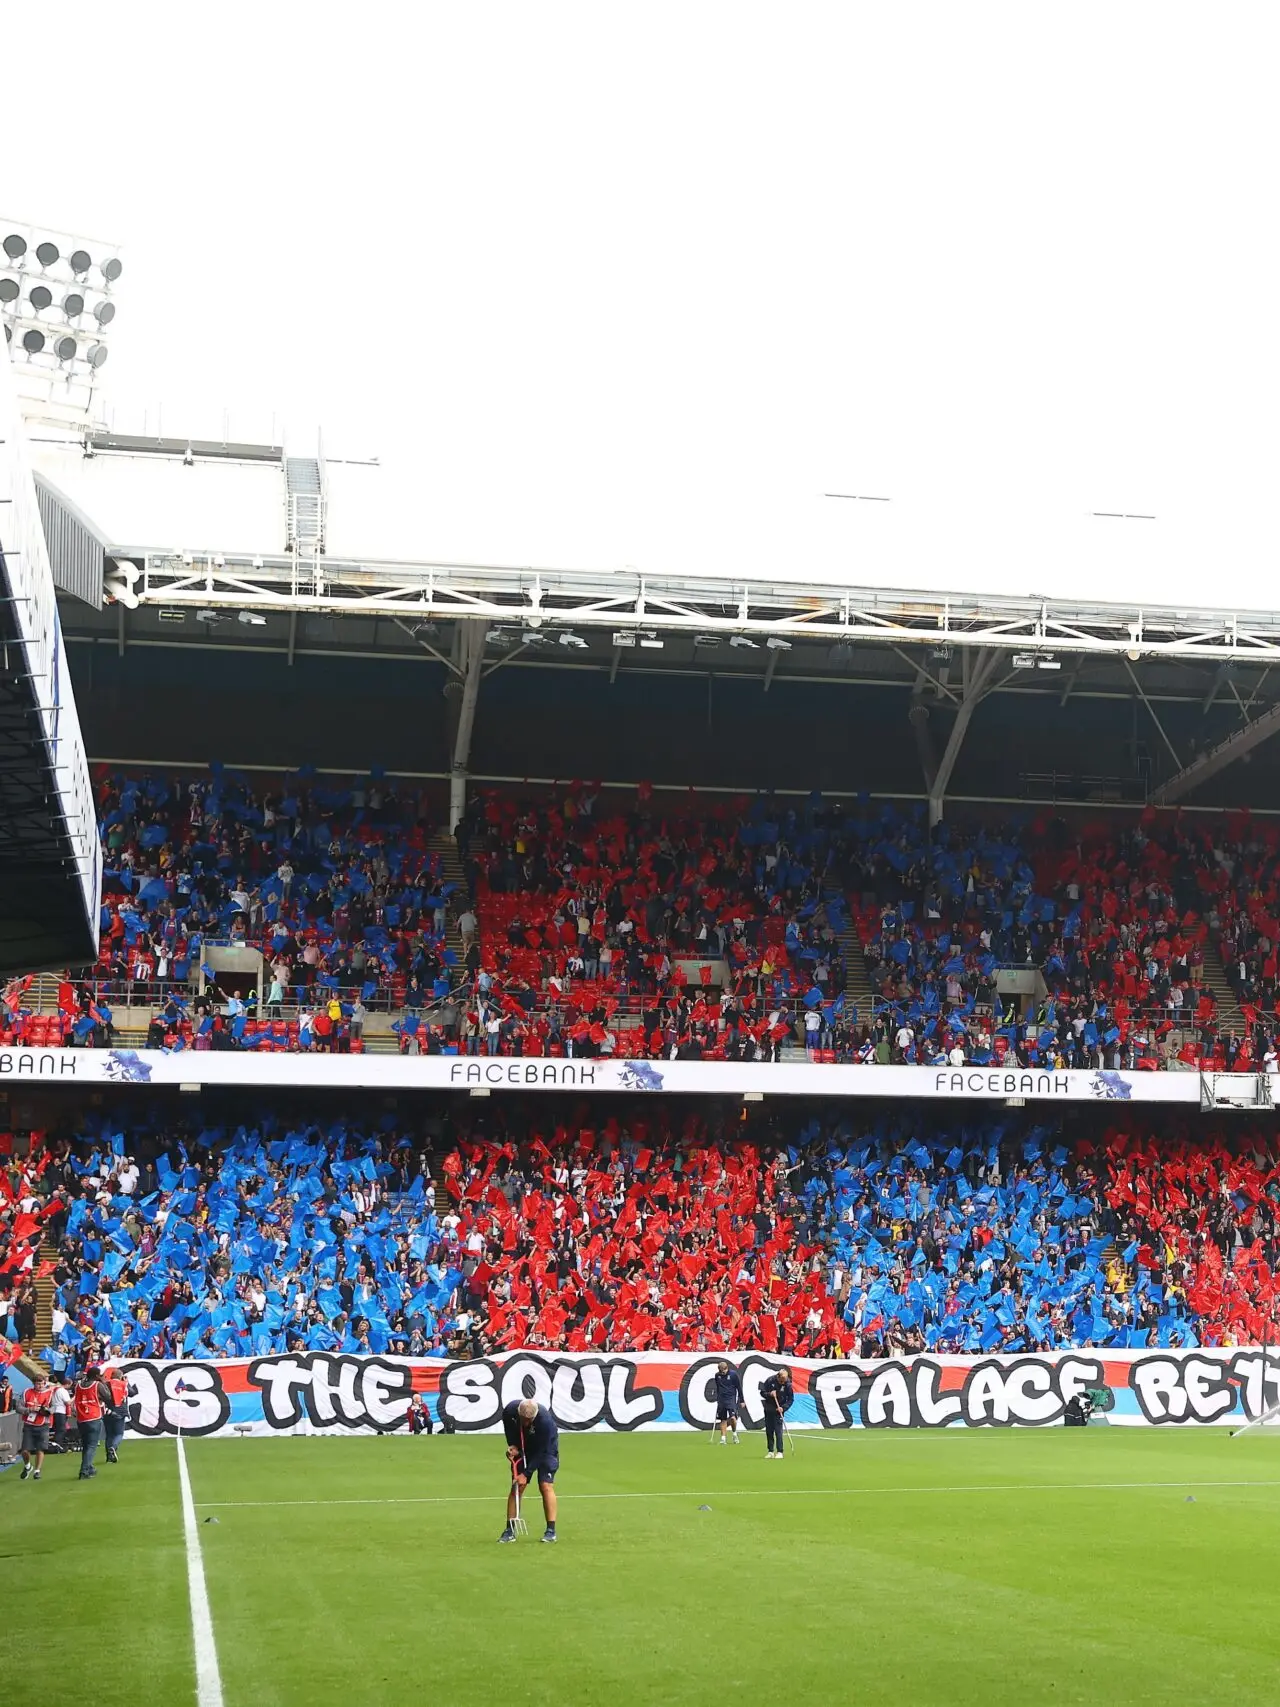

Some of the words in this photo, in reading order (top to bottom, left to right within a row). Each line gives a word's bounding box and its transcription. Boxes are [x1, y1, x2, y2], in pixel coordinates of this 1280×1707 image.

[450, 1063, 595, 1084] FACEBANK
[935, 1073, 1069, 1093] FACEBANK
[251, 1355, 411, 1430] THE
[441, 1357, 660, 1429] SOUL
[811, 1359, 1104, 1425] PALACE
